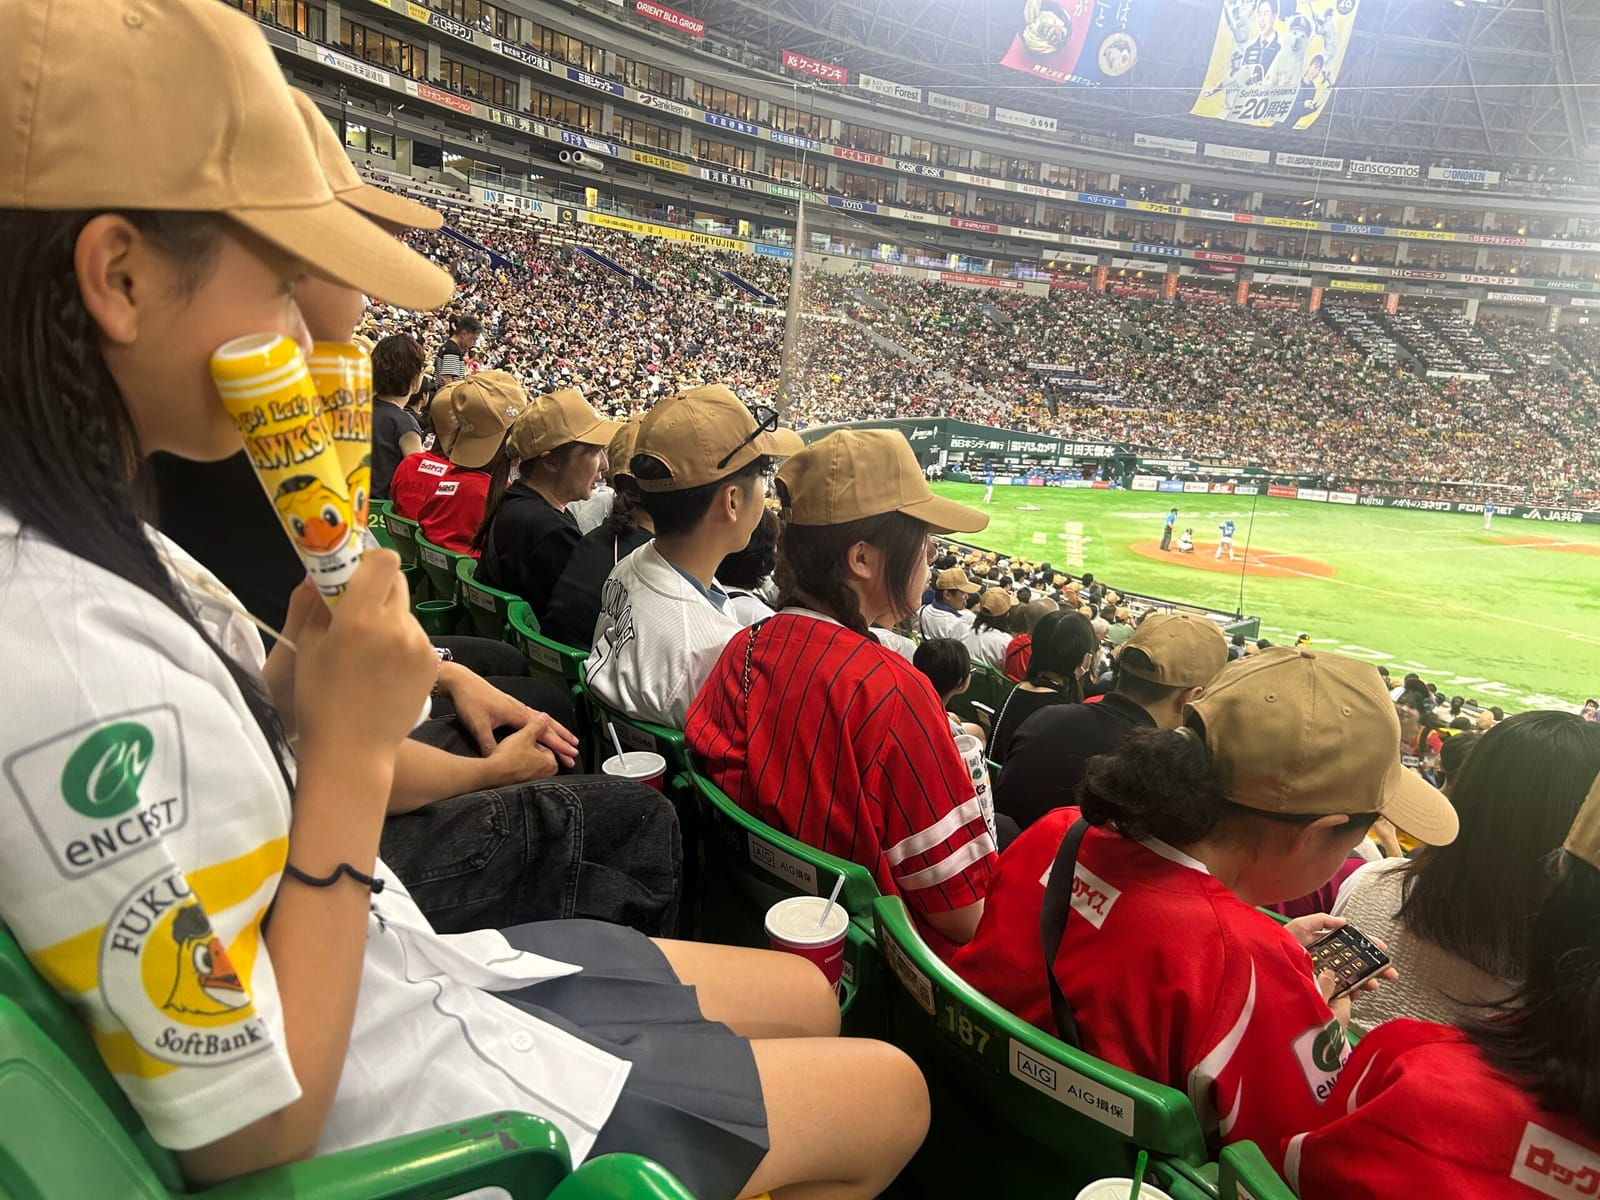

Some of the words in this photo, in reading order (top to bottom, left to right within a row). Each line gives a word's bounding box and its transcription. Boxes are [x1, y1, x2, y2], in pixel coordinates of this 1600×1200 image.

[636, 2, 664, 18] ORIENT
[663, 10, 678, 24] BLD.
[679, 18, 704, 33] GROUP
[440, 18, 472, 40] ロキテクノ
[894, 86, 919, 101] Forest
[898, 161, 917, 173] SCSK
[921, 166, 942, 177] SCSK
[1350, 161, 1419, 177] transcosmos
[1451, 170, 1486, 181] ONOKEN
[841, 199, 863, 210] TOTO
[690, 234, 735, 249] CHIKYUJIN
[950, 439, 1004, 450] 西日本シティ銀行
[1064, 443, 1116, 458] 日田天領水
[1360, 496, 1384, 506] FUJITSU
[1458, 503, 1515, 515] FORNET
[945, 1005, 990, 1054] 187
[156, 1020, 262, 1057] SoftBank
[1021, 1060, 1051, 1083] AIG
[1067, 1084, 1124, 1119] AIG損保
